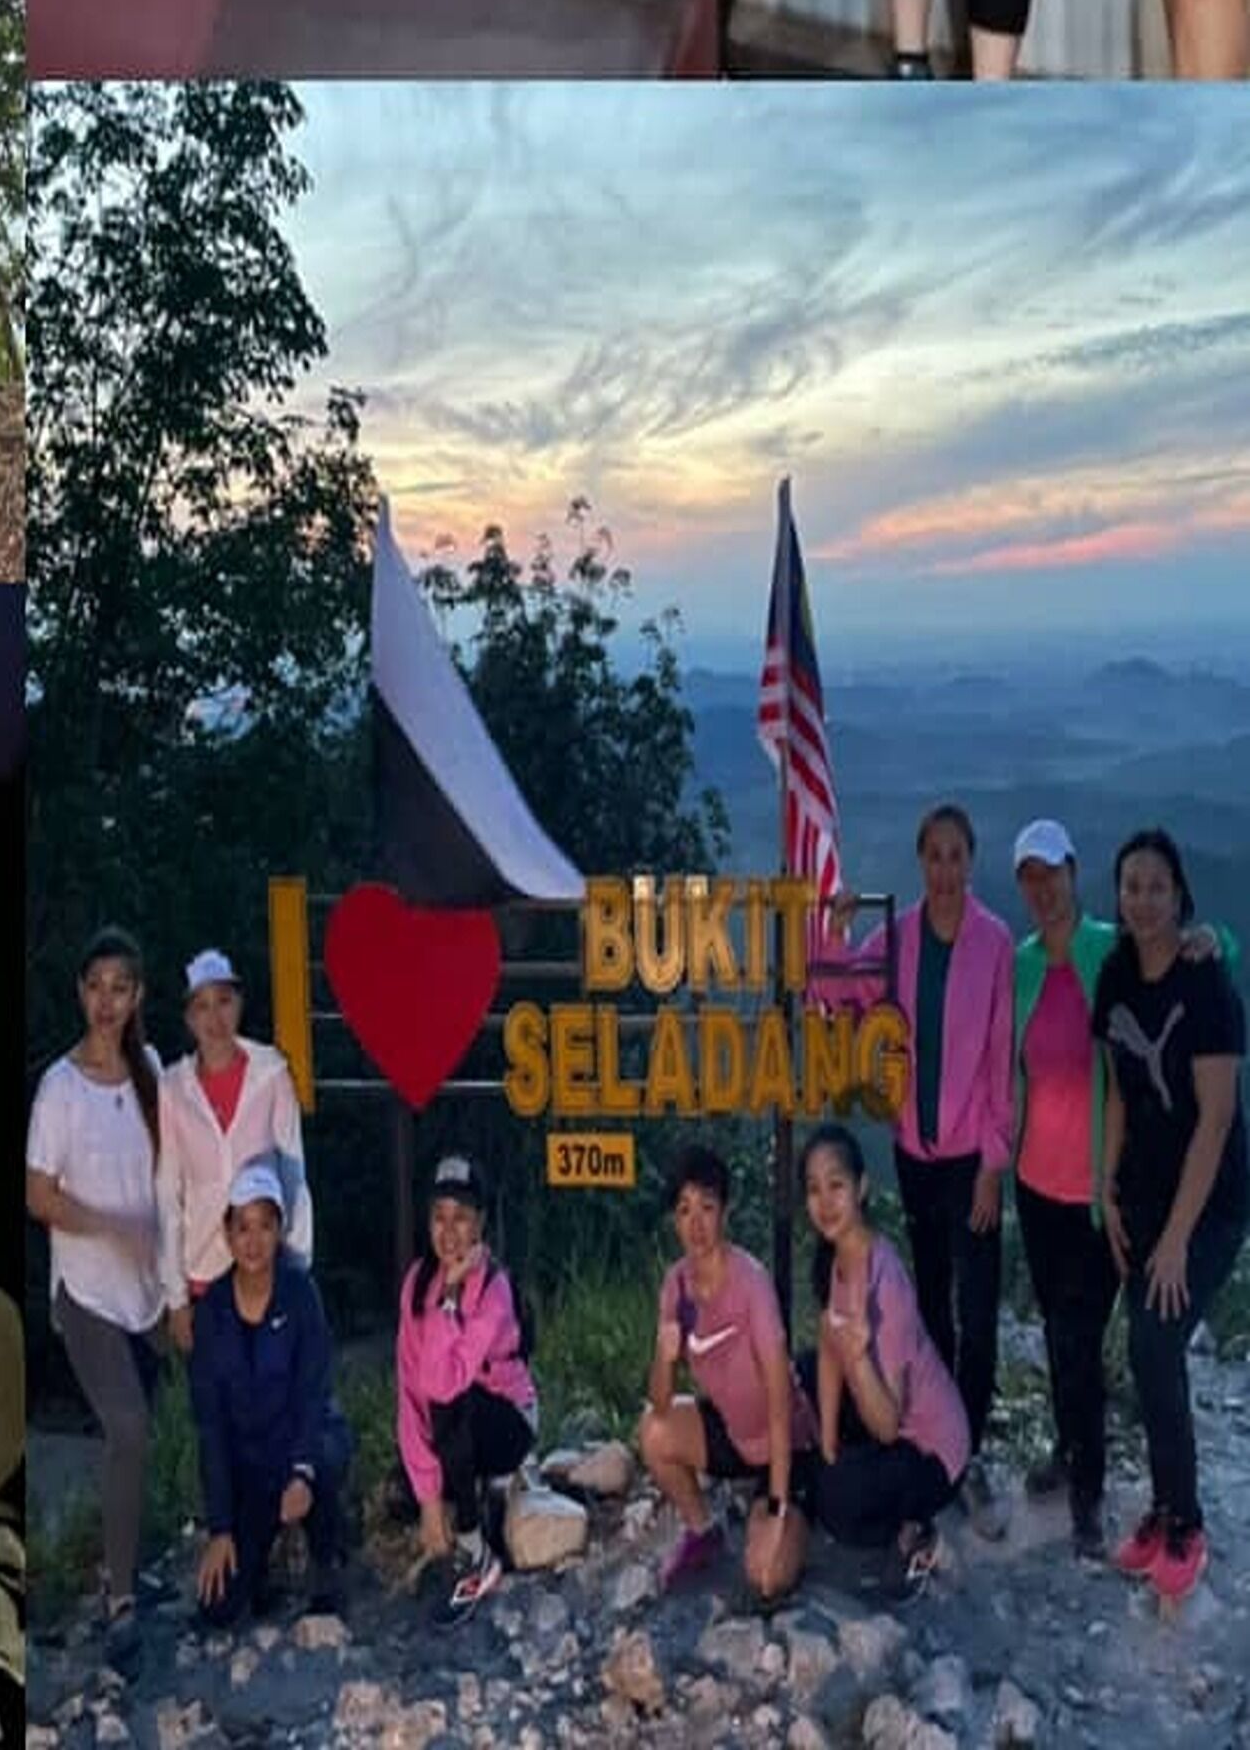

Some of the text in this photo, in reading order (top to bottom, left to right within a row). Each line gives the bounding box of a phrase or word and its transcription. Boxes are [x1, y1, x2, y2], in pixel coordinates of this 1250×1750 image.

[581, 874, 816, 994] BUKIT
[503, 1000, 909, 1119] SELADANG
[556, 1144, 626, 1178] 370m
